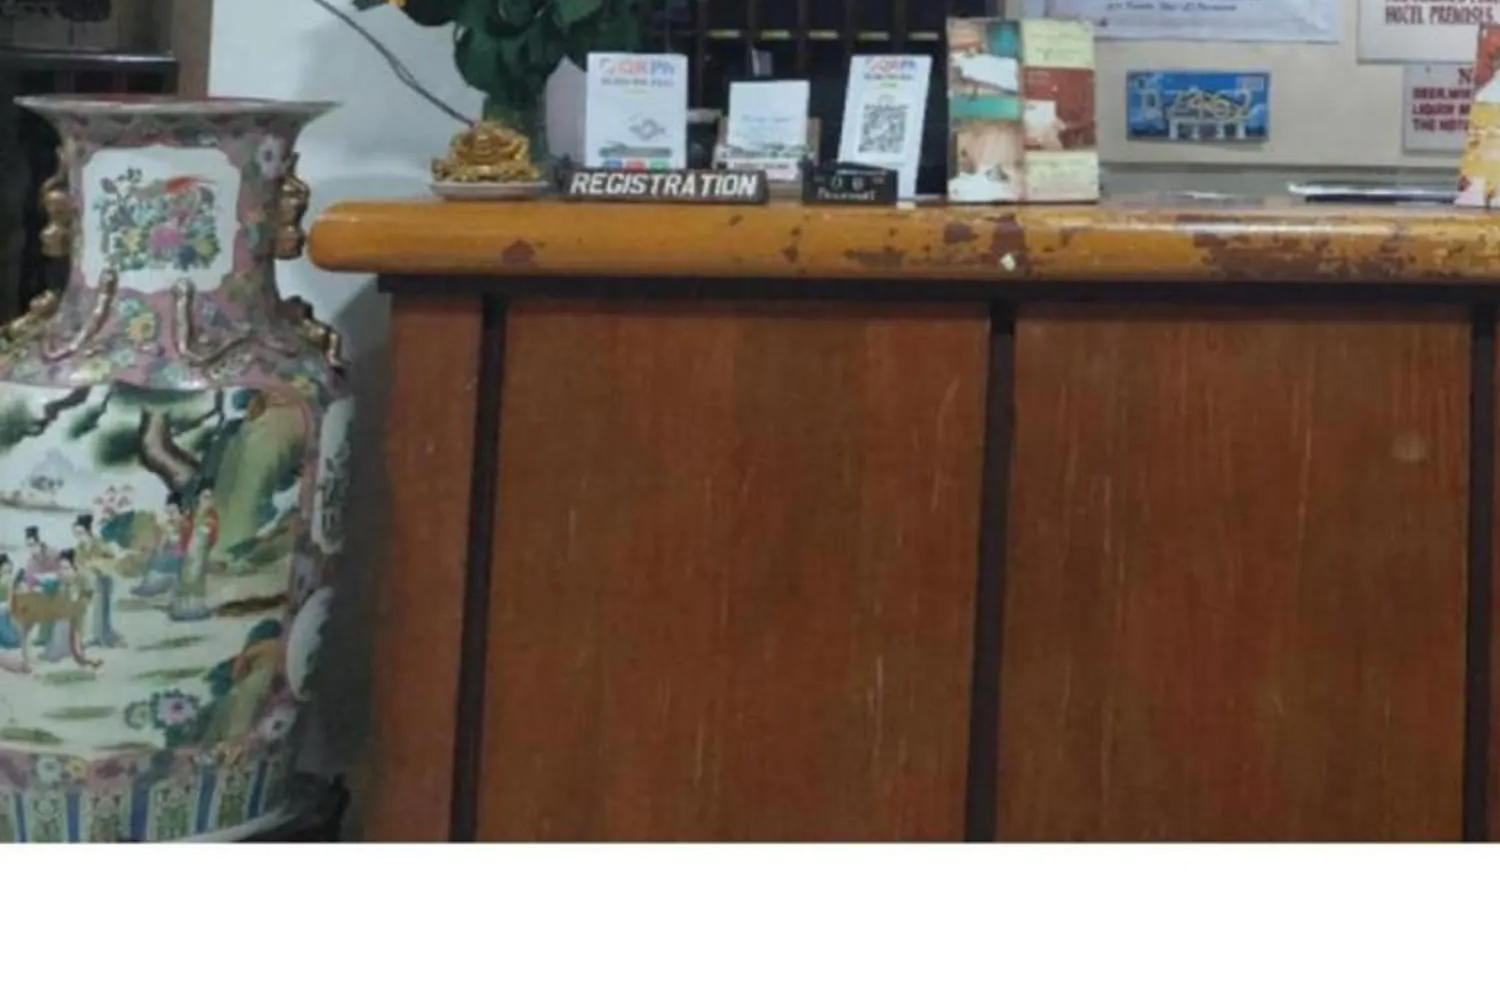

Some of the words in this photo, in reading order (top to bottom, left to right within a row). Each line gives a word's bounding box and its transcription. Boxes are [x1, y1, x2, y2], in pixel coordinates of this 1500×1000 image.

[1386, 6, 1422, 24] HOTEL
[1458, 67, 1474, 85] N
[1440, 118, 1470, 133] HOTE
[570, 172, 757, 196] REGISTRATION
